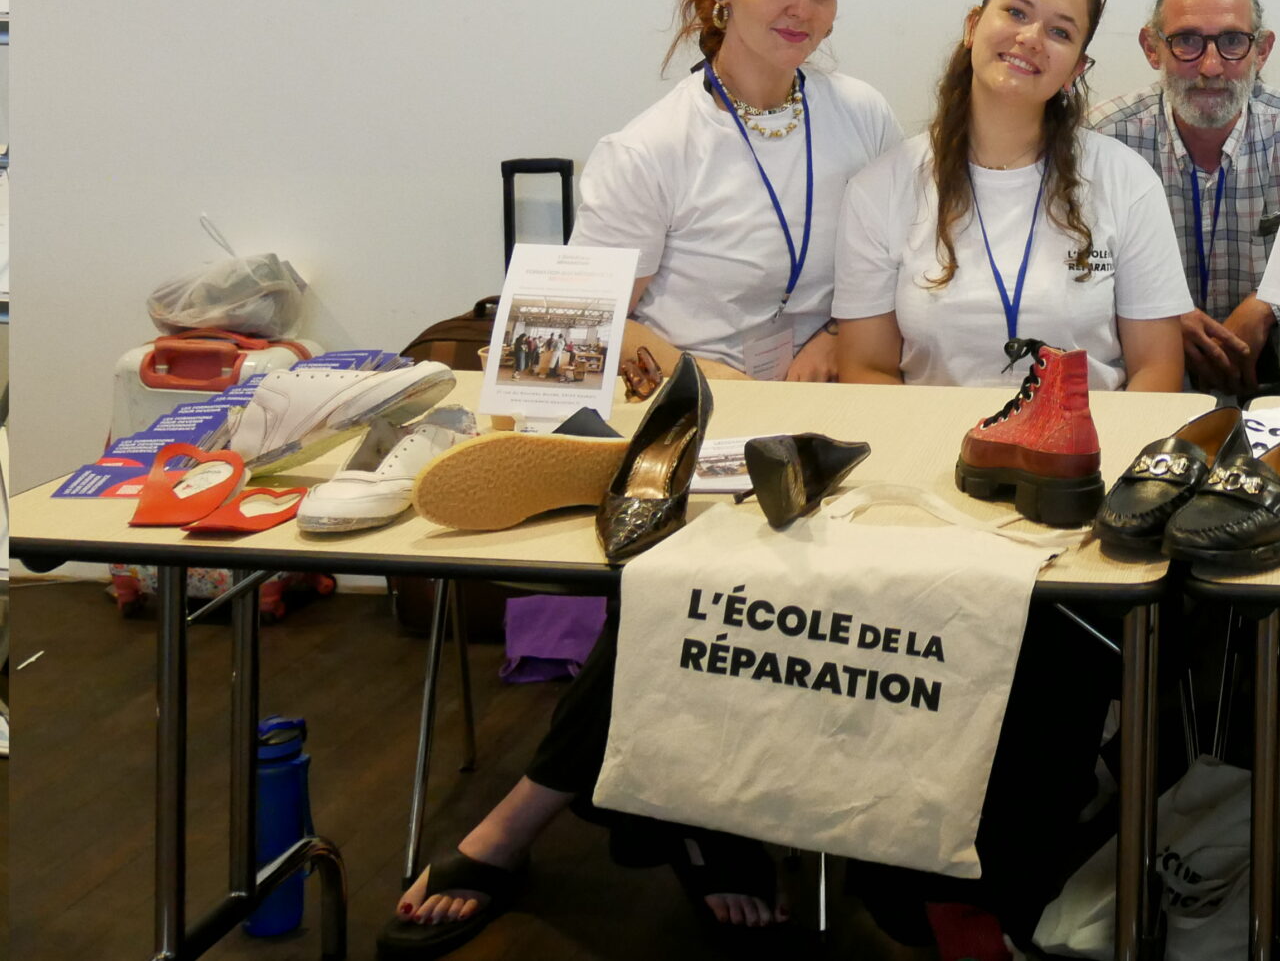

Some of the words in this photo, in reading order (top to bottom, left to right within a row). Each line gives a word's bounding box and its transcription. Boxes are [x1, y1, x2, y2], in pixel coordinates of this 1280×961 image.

[687, 584, 853, 645] L'ÉCOLE
[857, 623, 902, 654] DE
[905, 631, 945, 663] LA
[680, 633, 942, 712] RÉPARATION
